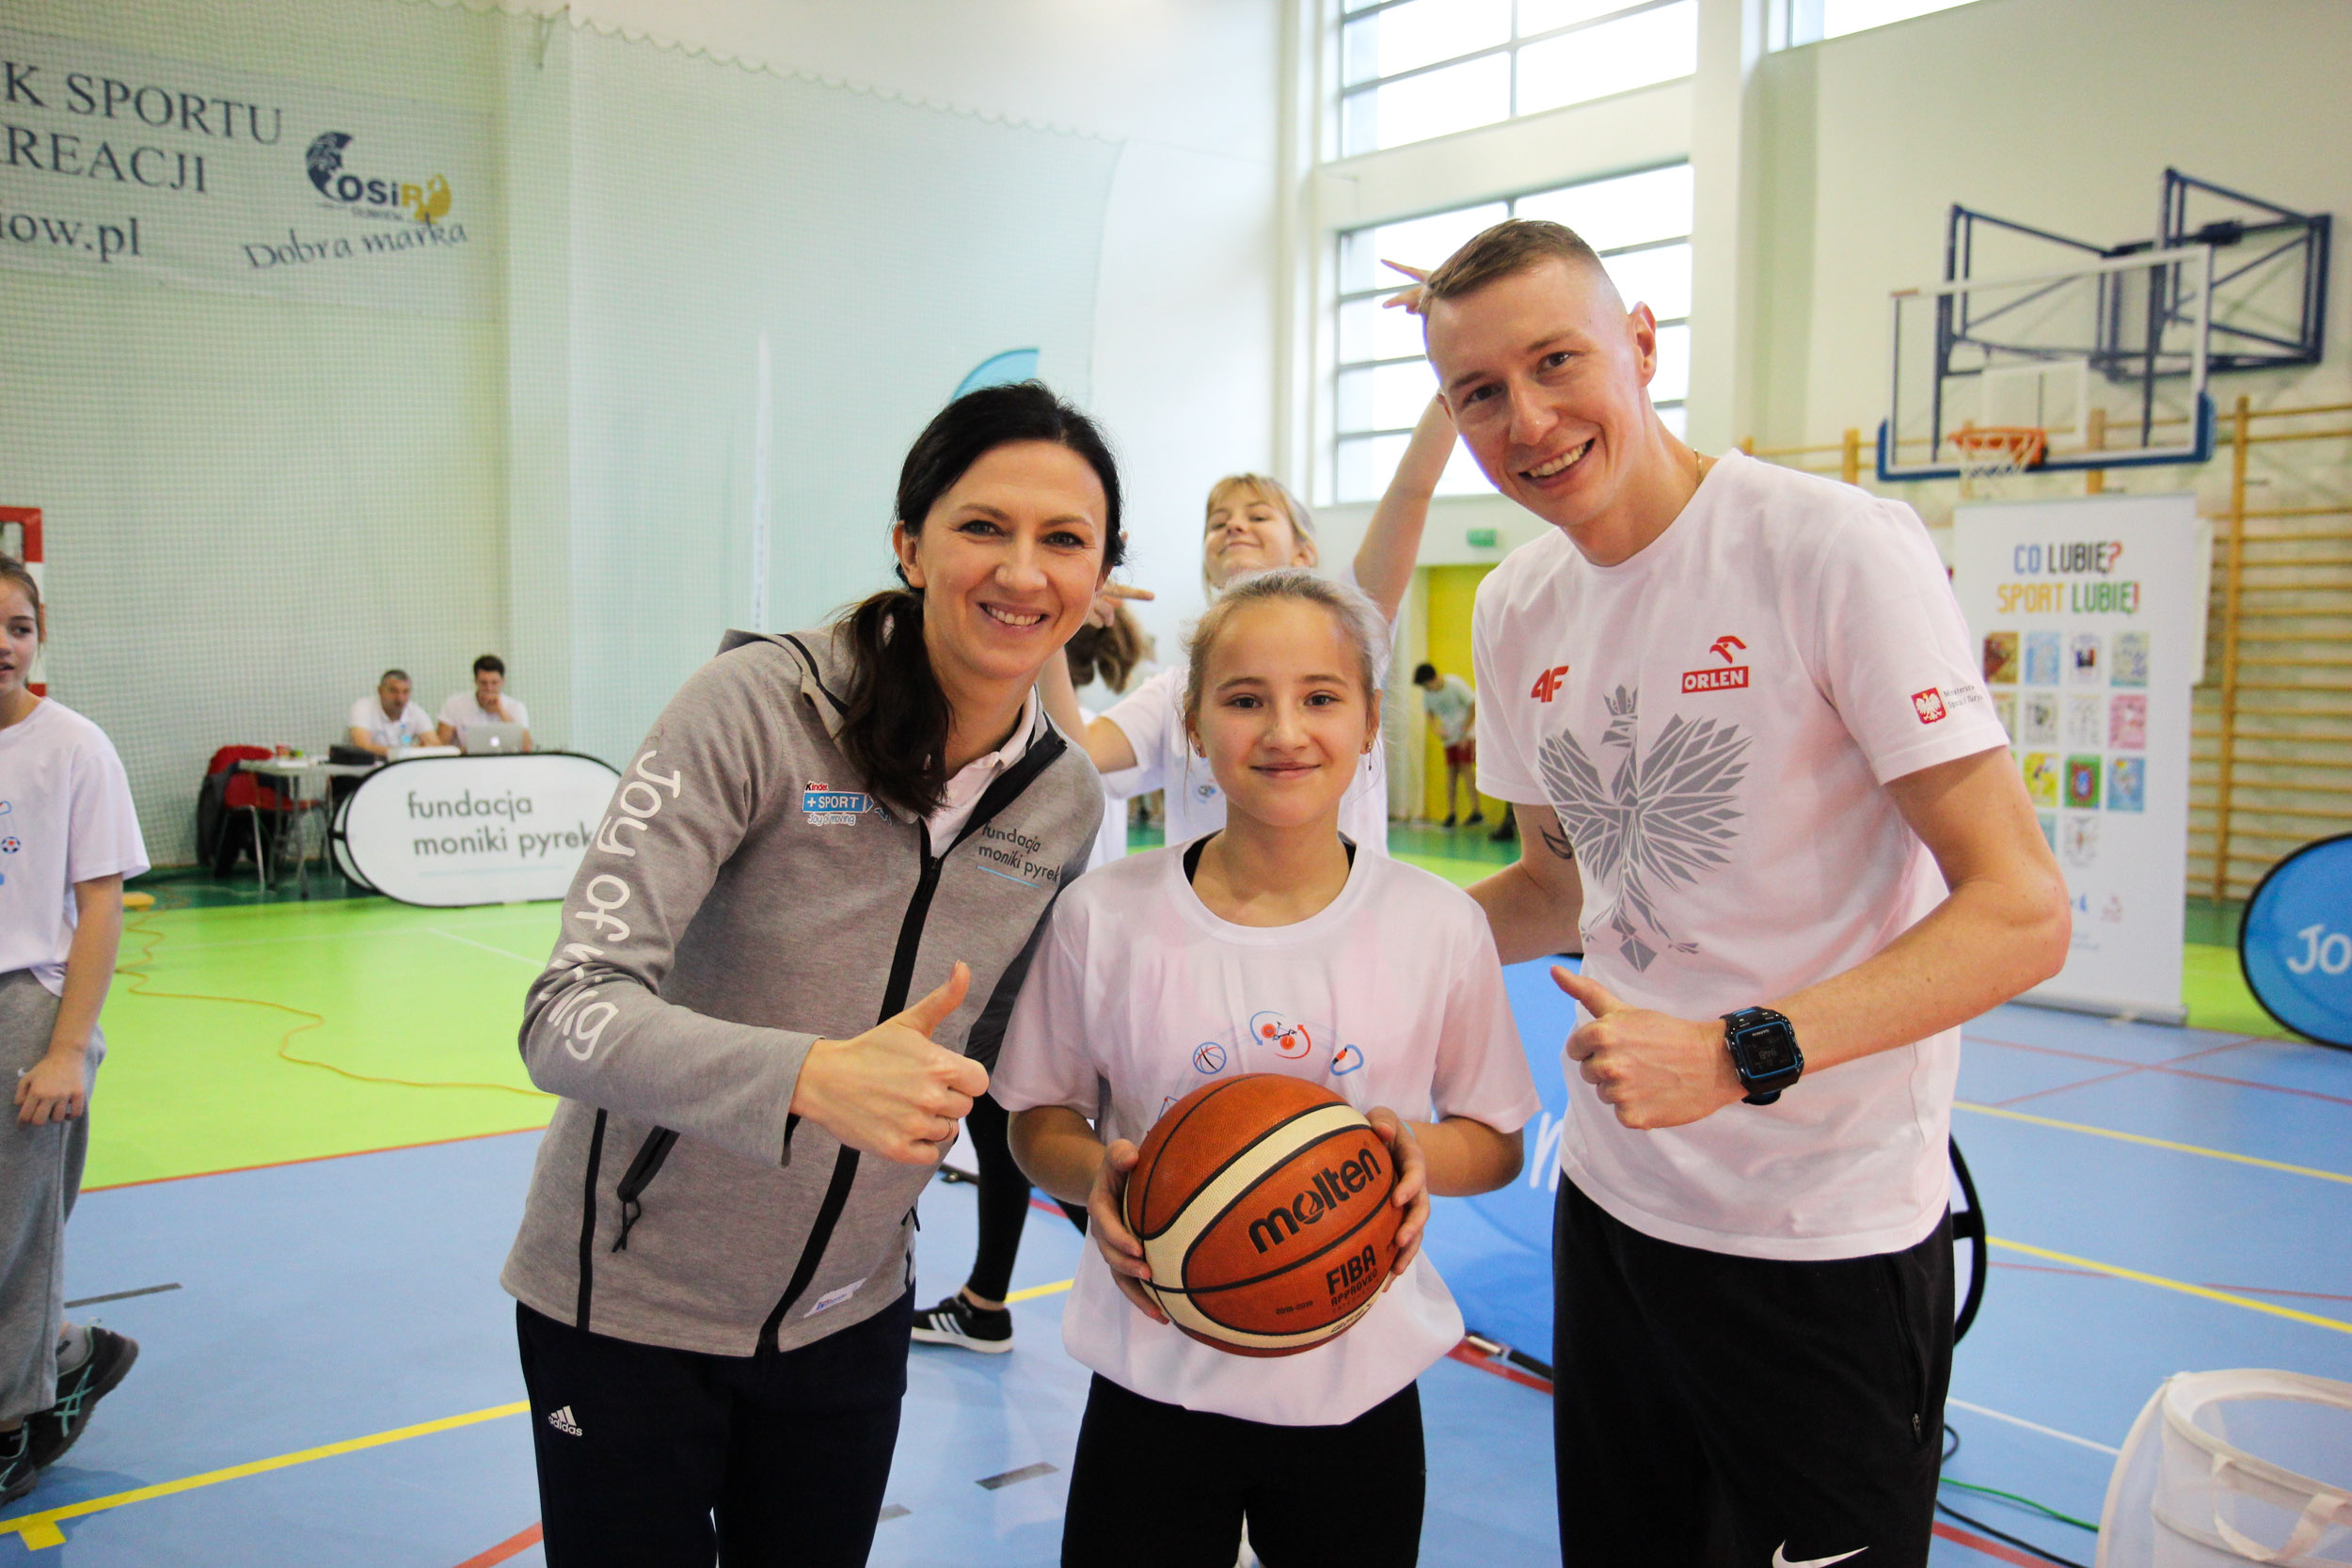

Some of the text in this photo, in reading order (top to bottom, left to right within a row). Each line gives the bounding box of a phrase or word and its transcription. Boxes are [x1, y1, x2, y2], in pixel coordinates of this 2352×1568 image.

[66, 72, 282, 146] SPORTU
[3, 123, 207, 193] REACJI
[244, 212, 468, 270] Dobra marka
[2014, 544, 2041, 575] CO
[1996, 582, 2065, 613] SPORT
[1531, 665, 1569, 703] 4F
[1684, 669, 1744, 689] ORLEN
[407, 790, 533, 822] fundacja
[597, 750, 681, 857] Joy
[808, 814, 823, 826] Joy
[414, 822, 594, 857] moniki pyrek
[982, 820, 1041, 854] fundacja
[978, 846, 1060, 882] moniki pyrek
[575, 874, 631, 942] of
[1248, 1148, 1382, 1255] molten
[1326, 1244, 1376, 1295] FIBA
[1330, 1268, 1378, 1307] APPROVED
[548, 1416, 583, 1436] adidas
